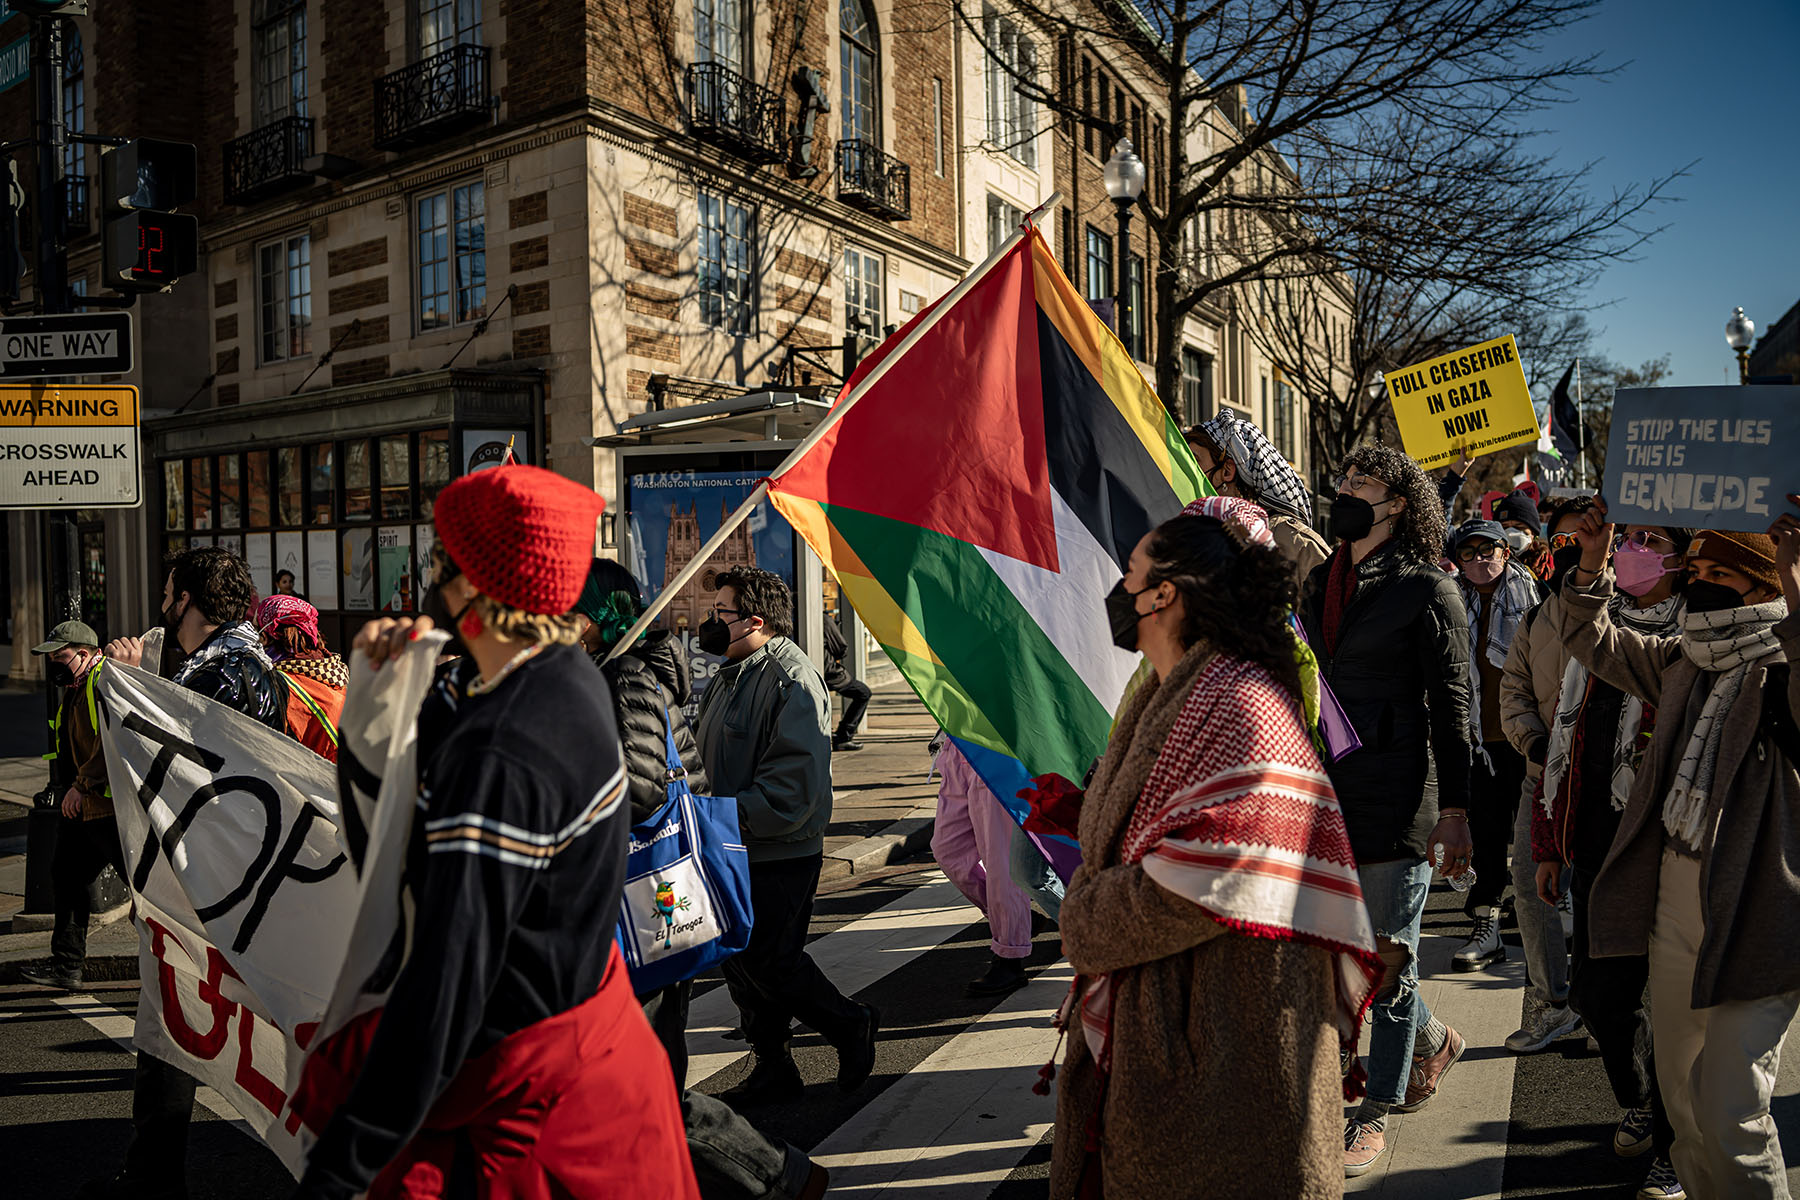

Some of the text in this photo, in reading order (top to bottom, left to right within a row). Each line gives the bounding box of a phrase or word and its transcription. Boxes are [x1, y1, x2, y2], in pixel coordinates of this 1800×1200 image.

[7, 332, 111, 359] ONE WAY
[1391, 343, 1514, 397] FULL CEASEFIRE
[0, 400, 119, 417] WARNING
[1426, 379, 1492, 415] IN GAZA
[1442, 408, 1490, 439] NOW!
[1627, 419, 1772, 446] STOP THE LIES
[1625, 444, 1686, 467] THIS IS
[22, 470, 100, 486] AHEAD
[637, 478, 762, 490] WASHINGTON NATIONAL CATH
[1619, 472, 1771, 517] GENOCIDE
[379, 535, 398, 547] SPIRIT
[97, 692, 347, 955] TOP
[671, 916, 704, 936] Torogoz
